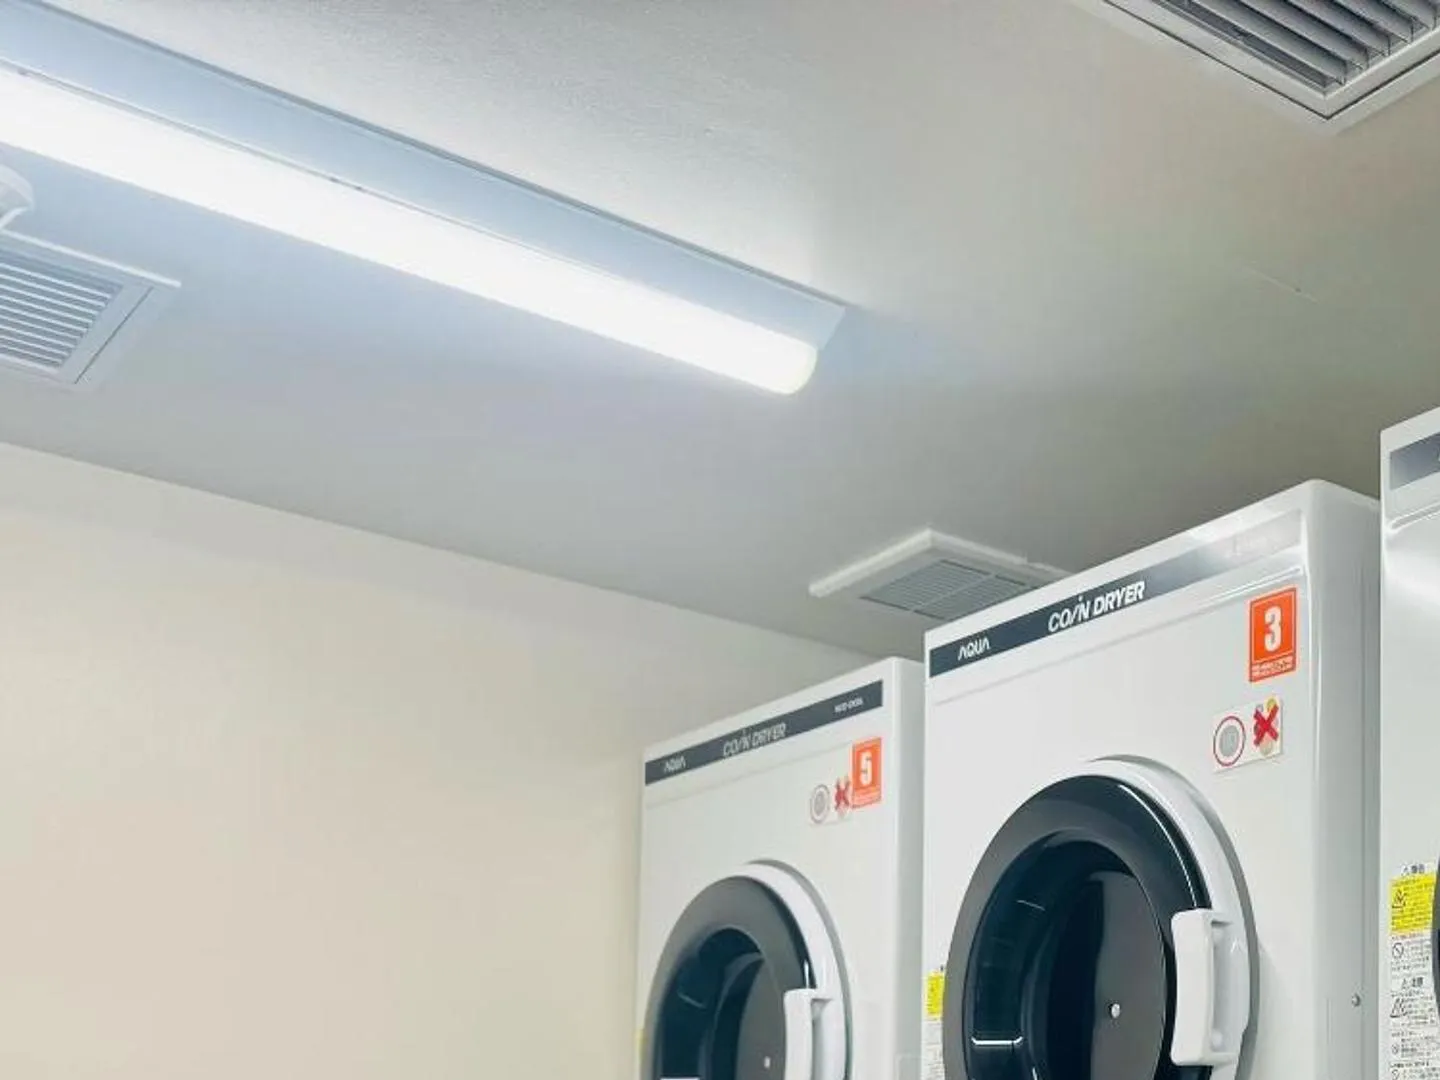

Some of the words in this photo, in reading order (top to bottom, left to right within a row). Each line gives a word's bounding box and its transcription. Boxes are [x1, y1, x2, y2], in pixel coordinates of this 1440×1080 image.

[1093, 580, 1145, 616] DRYER
[1264, 605, 1282, 652] 3
[958, 636, 990, 661] AQUA
[860, 751, 872, 785] 5
